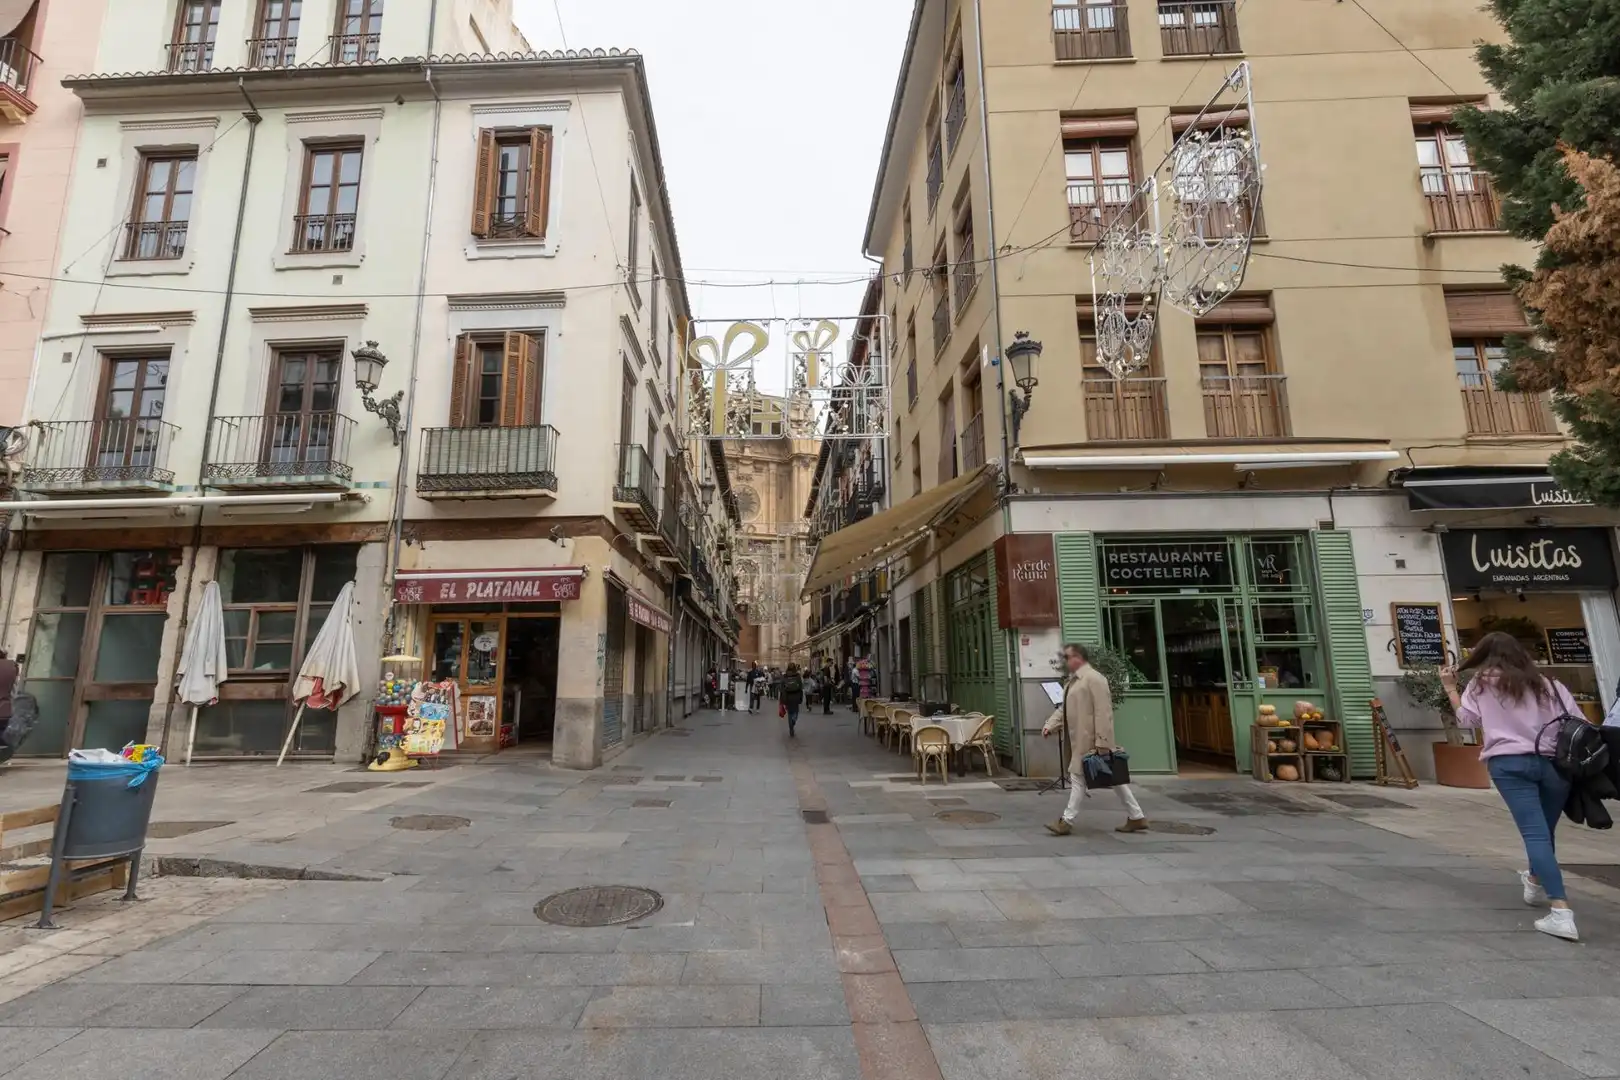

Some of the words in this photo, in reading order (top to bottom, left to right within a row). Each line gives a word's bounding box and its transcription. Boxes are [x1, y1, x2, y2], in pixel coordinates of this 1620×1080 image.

[1108, 551, 1224, 564] RESTAURANTE
[1471, 534, 1582, 572] Luisitas
[1110, 565, 1210, 579] COCTELERÍA
[439, 582, 456, 599] EL
[466, 580, 541, 598] PLATANAL
